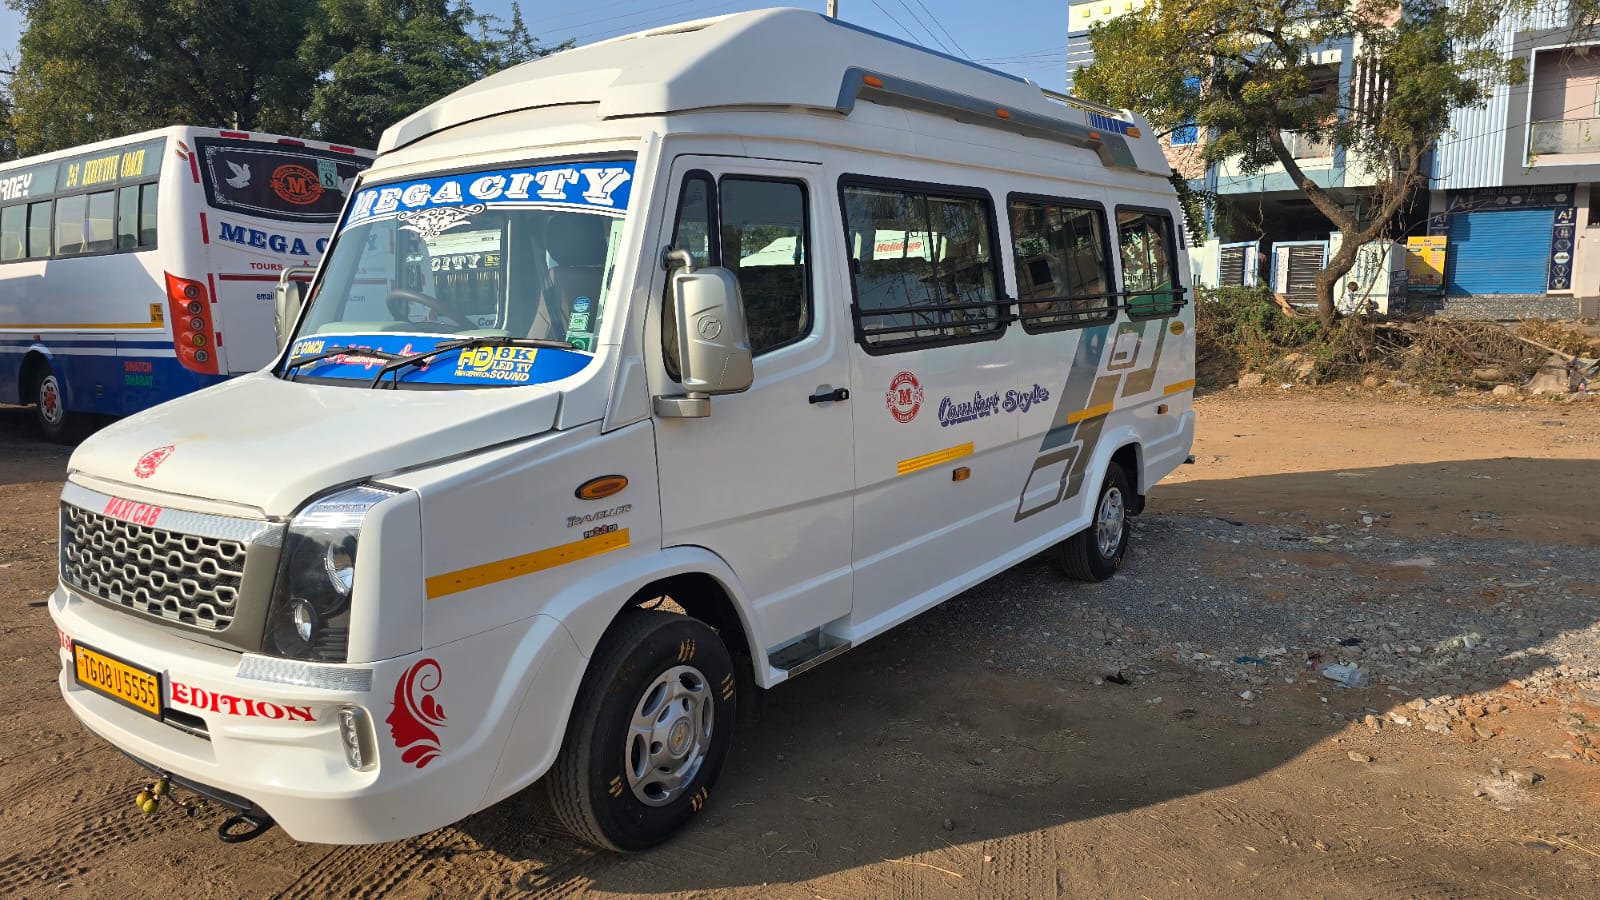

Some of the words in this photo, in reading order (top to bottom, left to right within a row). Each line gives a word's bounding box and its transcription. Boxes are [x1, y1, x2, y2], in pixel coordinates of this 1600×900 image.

[83, 155, 120, 185] EXECUTIVE
[121, 149, 145, 178] COACH
[288, 177, 308, 194] M
[351, 181, 462, 221] MEGA
[468, 167, 631, 206] CITY
[218, 222, 310, 255] MEGA
[249, 262, 284, 271] TOURS
[457, 346, 495, 372] HD
[491, 361, 514, 371] LED
[516, 363, 532, 373] TV
[489, 370, 529, 382] SOUND
[1002, 383, 1050, 413] Style
[102, 496, 134, 519] MAXI
[132, 503, 163, 527] CAB
[170, 681, 318, 721] EDITION
